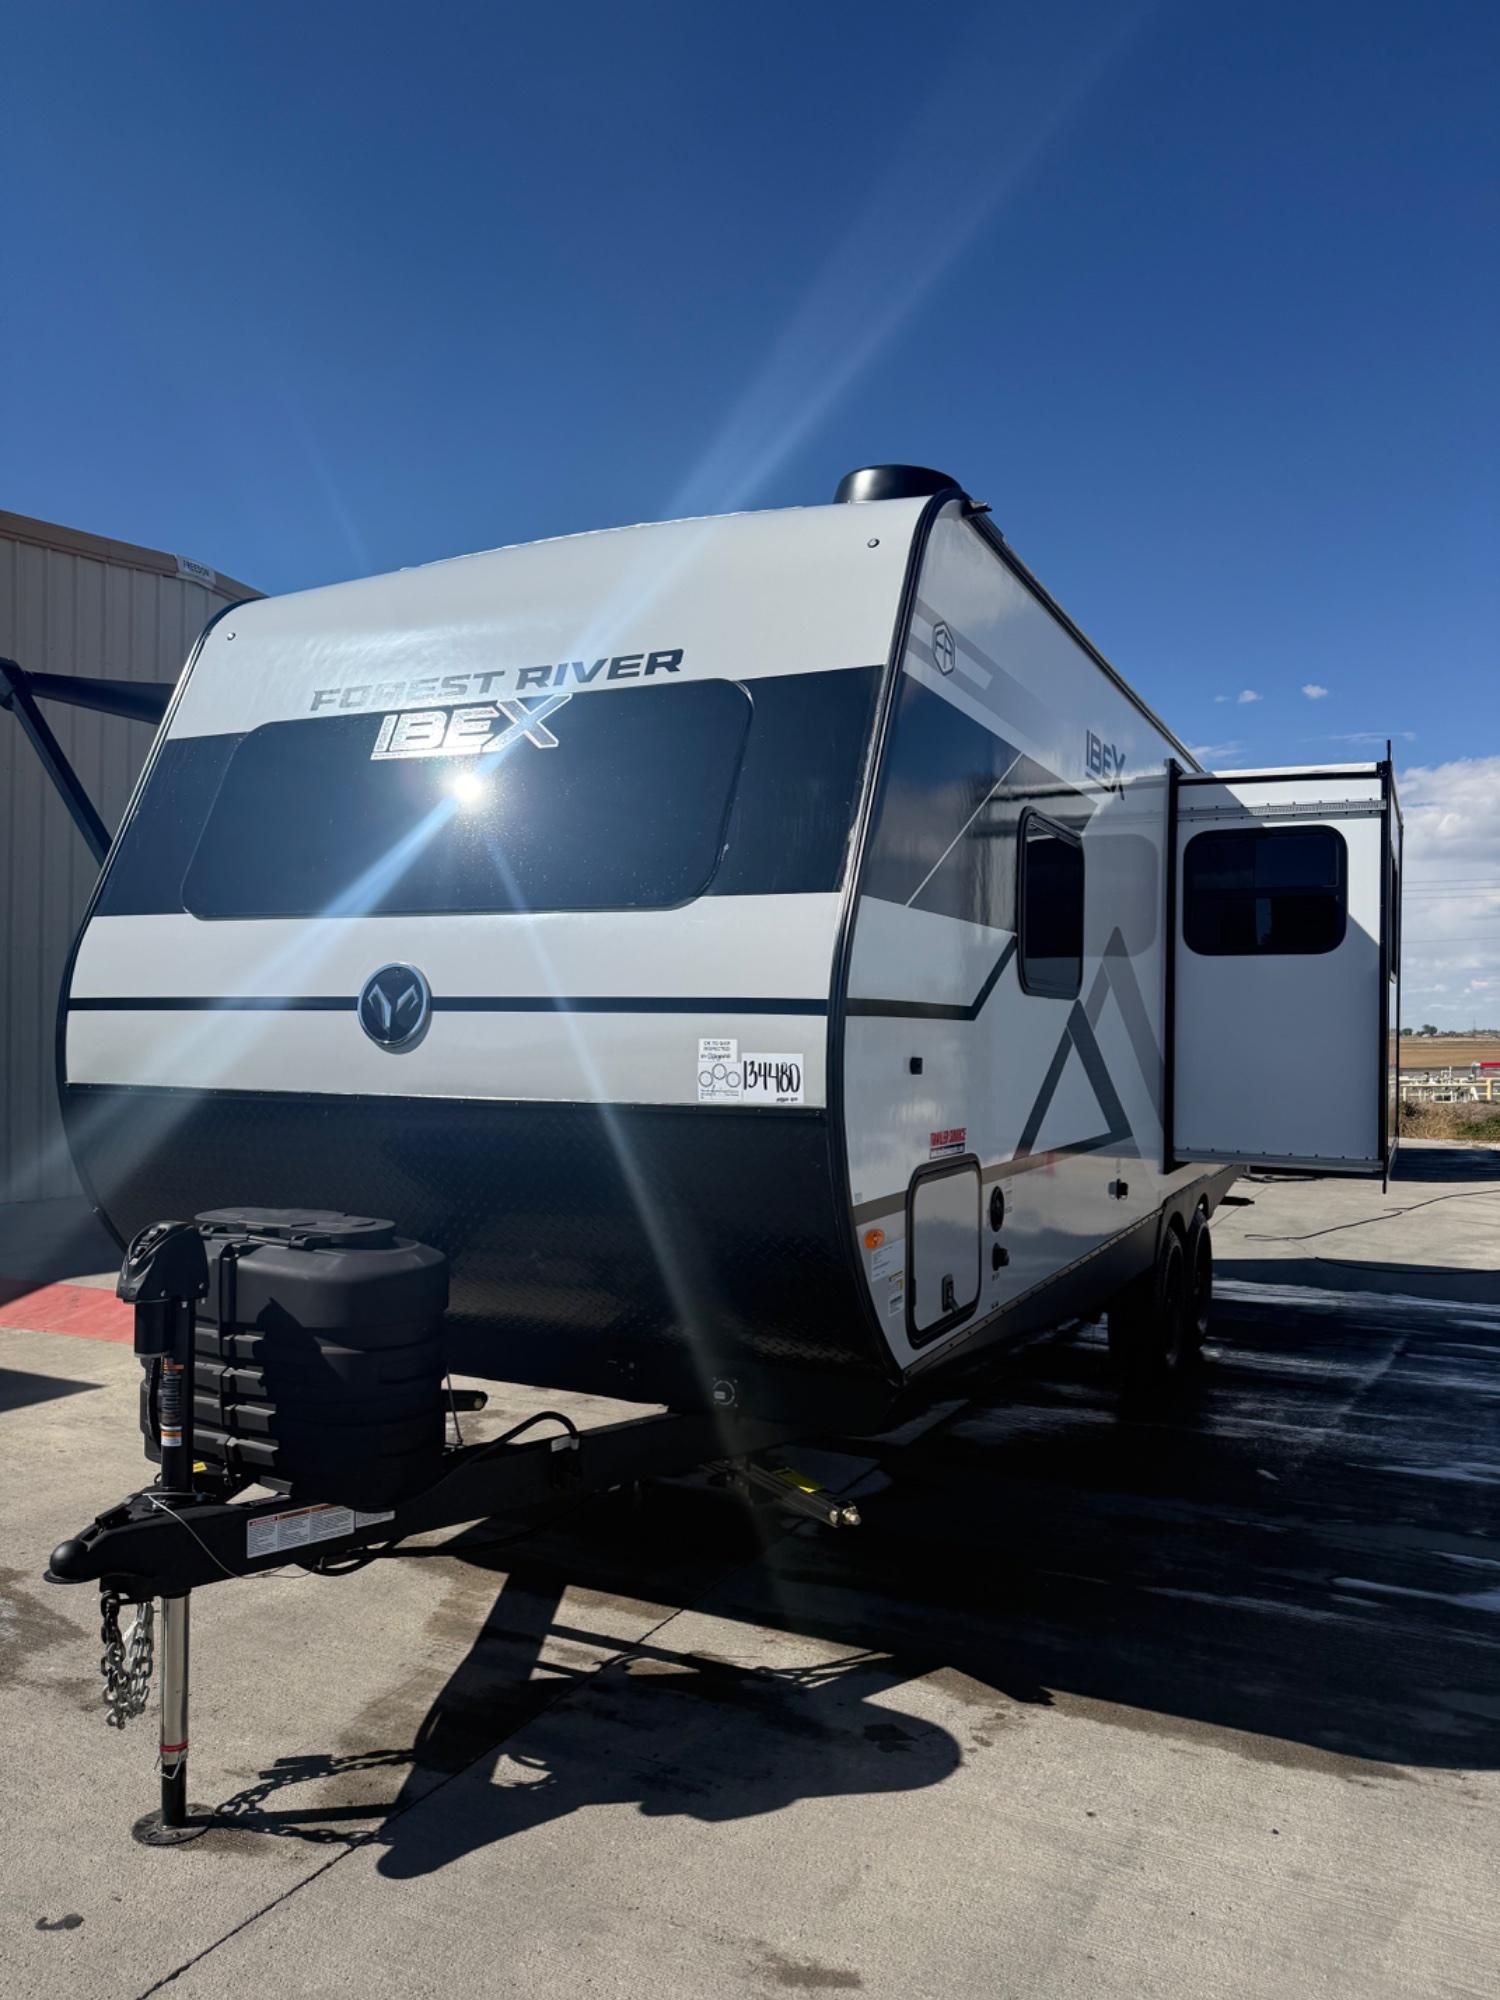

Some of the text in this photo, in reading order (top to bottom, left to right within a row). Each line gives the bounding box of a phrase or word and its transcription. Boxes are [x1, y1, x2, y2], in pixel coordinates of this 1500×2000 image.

[310, 649, 684, 712] FOREST RIVER
[370, 693, 573, 760] IBEX
[1085, 729, 1126, 801] IBEX
[743, 1060, 801, 1093] 134480
